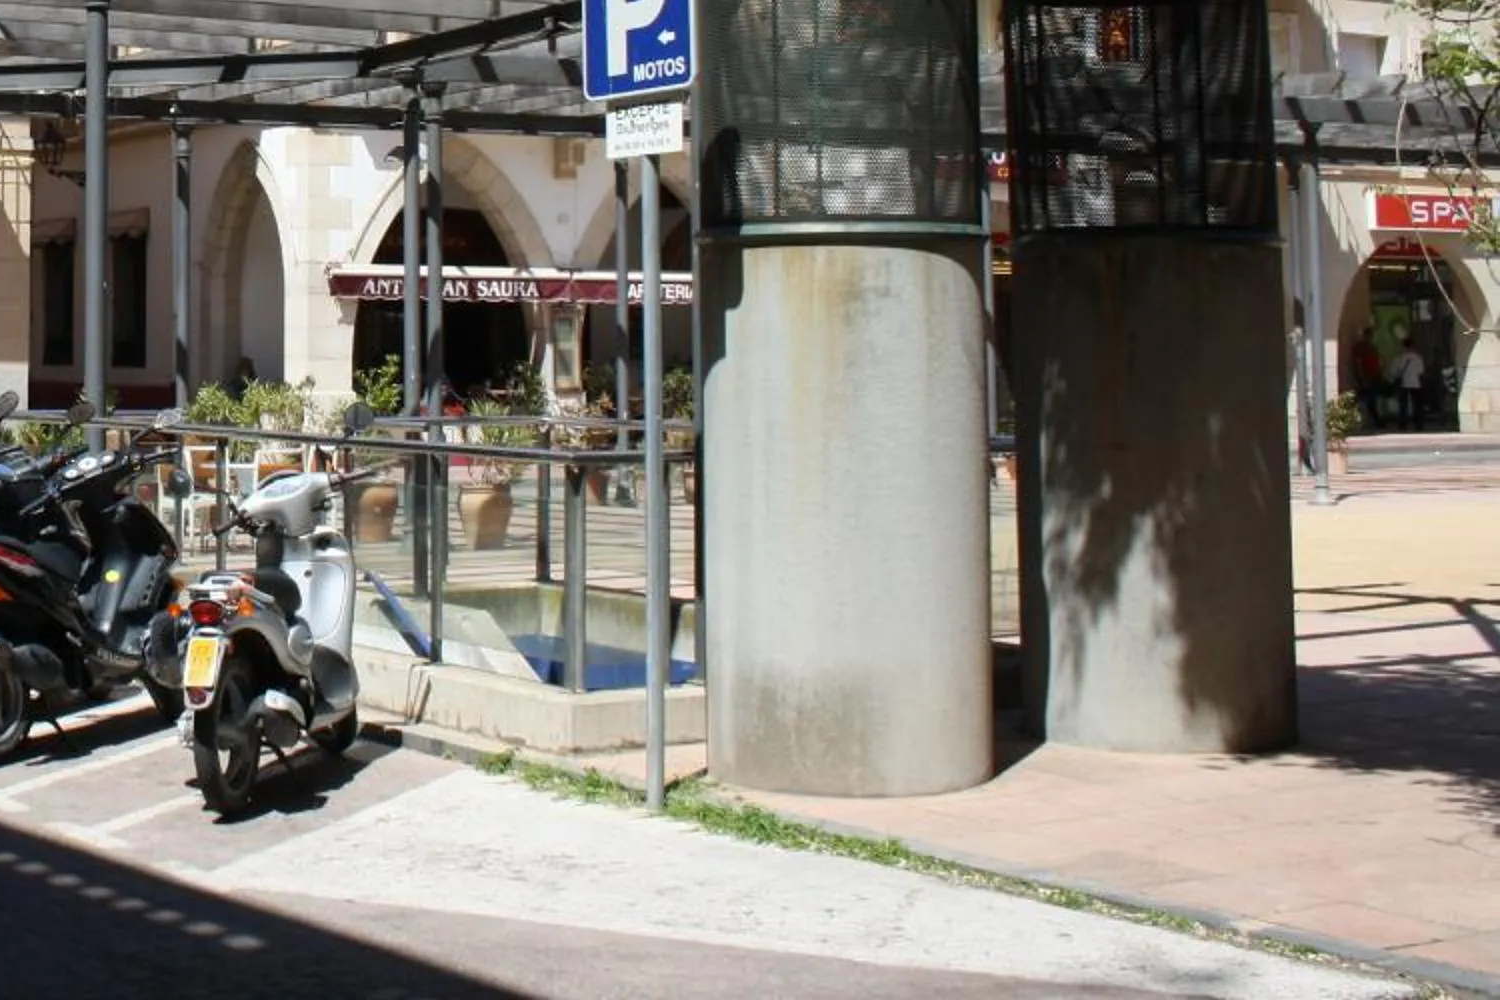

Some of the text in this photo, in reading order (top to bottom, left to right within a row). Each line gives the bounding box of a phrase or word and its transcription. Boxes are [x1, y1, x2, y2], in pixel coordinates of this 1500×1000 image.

[633, 55, 686, 83] MOTOS
[1410, 200, 1475, 224] SPA
[362, 277, 540, 298] ANT AN SAURA
